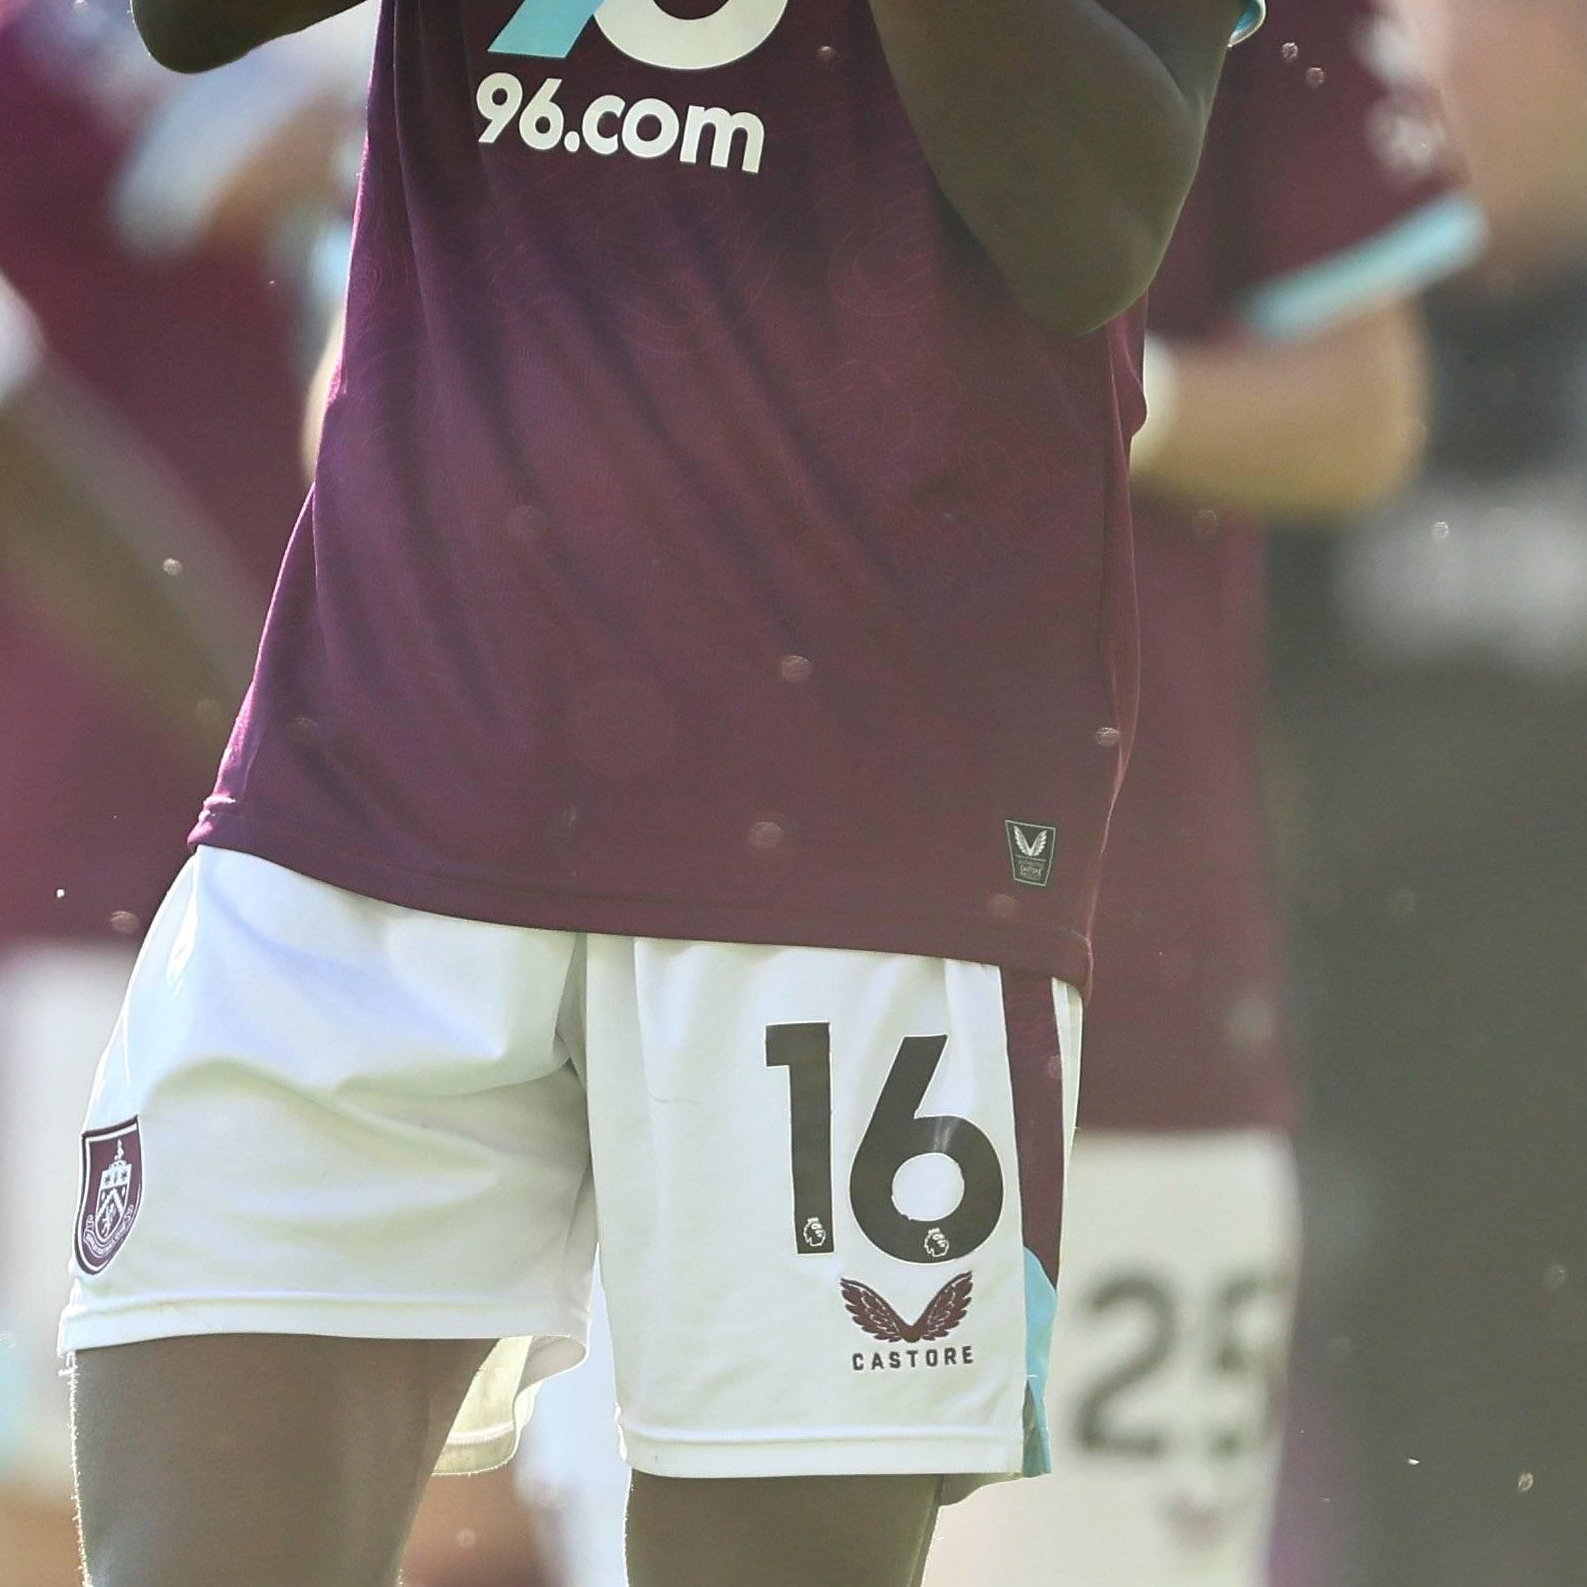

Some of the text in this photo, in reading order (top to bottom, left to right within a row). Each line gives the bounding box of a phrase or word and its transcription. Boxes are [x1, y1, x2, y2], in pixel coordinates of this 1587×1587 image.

[476, 72, 765, 173] 96.com
[765, 1021, 1004, 1264] 16
[852, 1345, 974, 1371] CASTORE
